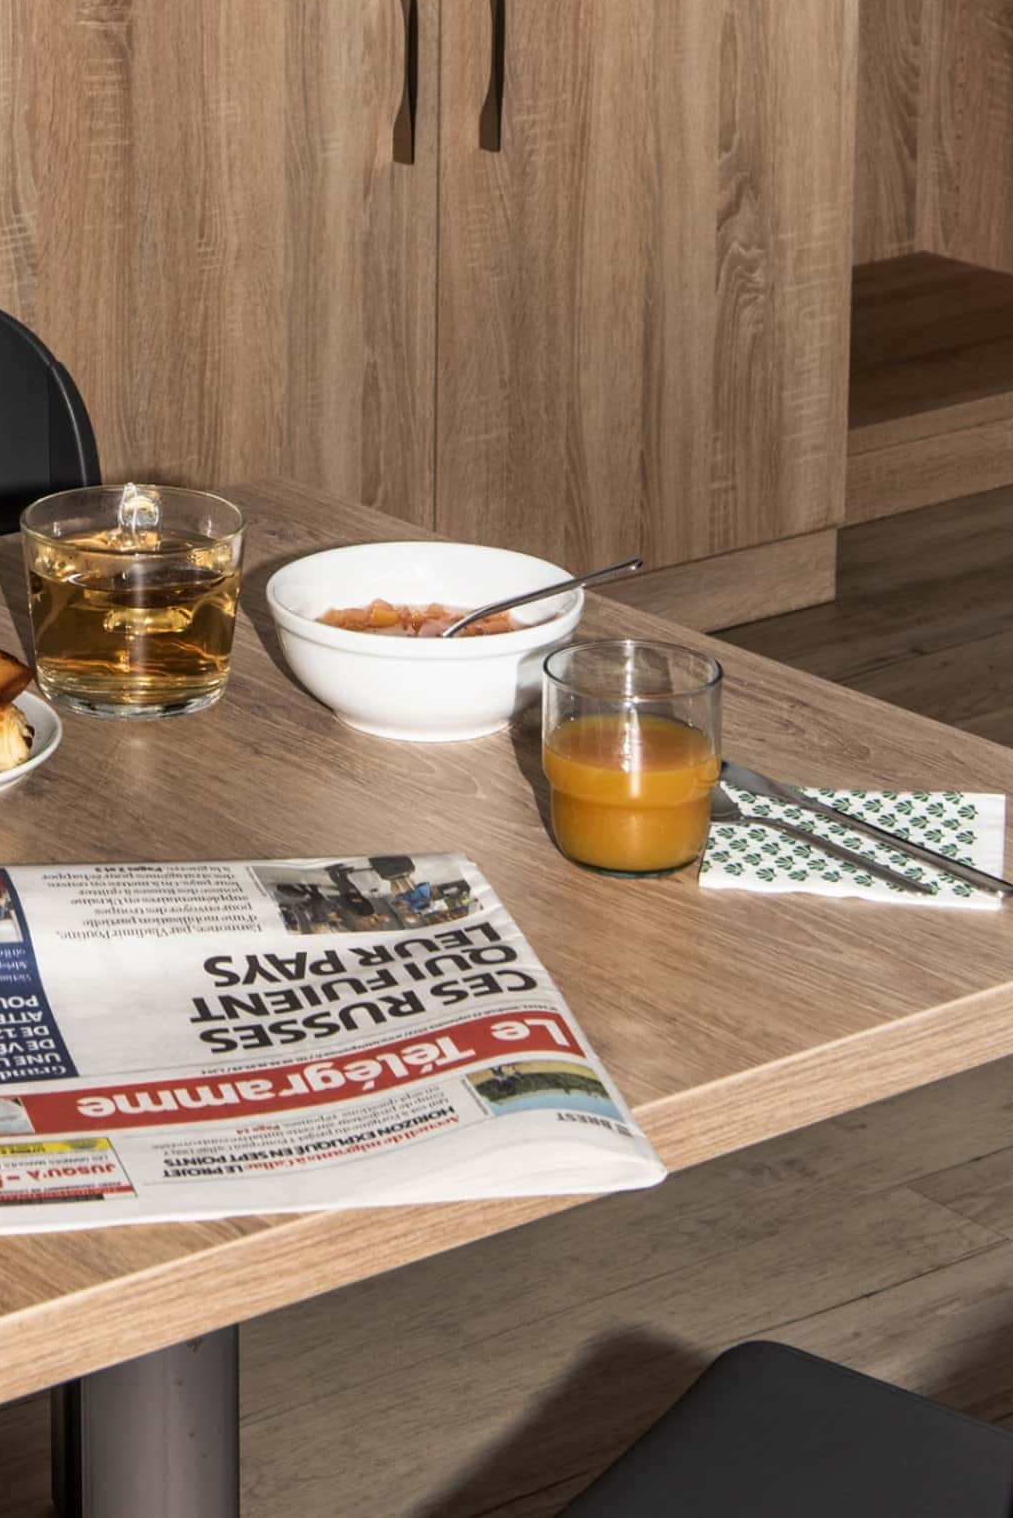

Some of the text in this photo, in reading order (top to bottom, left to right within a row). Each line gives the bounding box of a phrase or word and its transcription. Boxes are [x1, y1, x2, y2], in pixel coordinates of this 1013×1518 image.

[113, 929, 169, 939] Vladimir
[203, 921, 502, 988] LEUR PAYS
[190, 944, 518, 1023] QUI FUIENT
[199, 969, 538, 1054] CES RUSSES
[20, 1025, 50, 1037] DE
[26, 1038, 56, 1051] DE
[12, 1052, 61, 1067] UNE
[76, 1018, 570, 1116] Le Télégramme
[163, 1106, 455, 1168] HORIZON EXPLIQUÉ EN SEPT POINTS
[405, 1116, 459, 1139] Accueil
[307, 1141, 382, 1162] migrants
[27, 1162, 116, 1181] JUSQU'À
[163, 1166, 223, 1179] PROJET
[224, 1165, 244, 1174] LE
